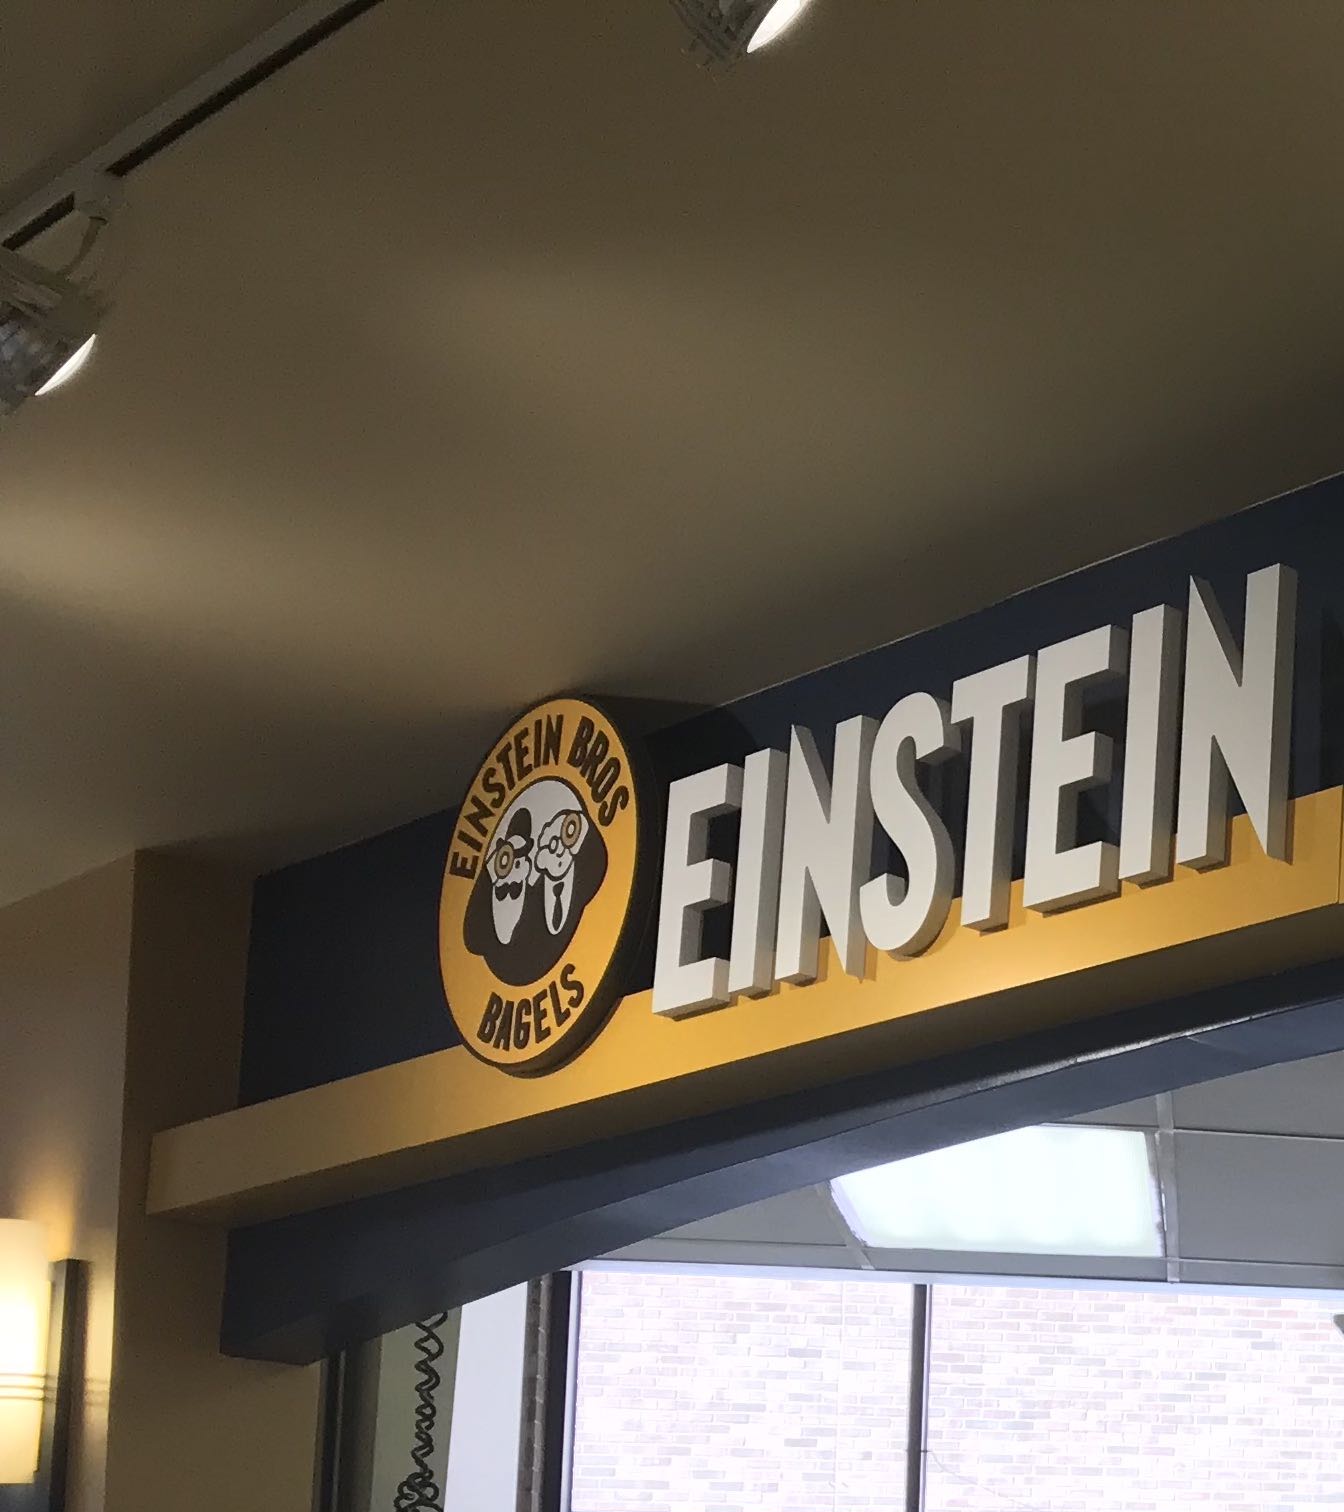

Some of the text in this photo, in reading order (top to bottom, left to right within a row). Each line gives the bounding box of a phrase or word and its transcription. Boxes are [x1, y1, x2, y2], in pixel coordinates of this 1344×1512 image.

[450, 714, 629, 879] EINSTEIN BROS
[652, 562, 1297, 1016] EINSTEIN
[477, 963, 584, 1052] BAGELS
